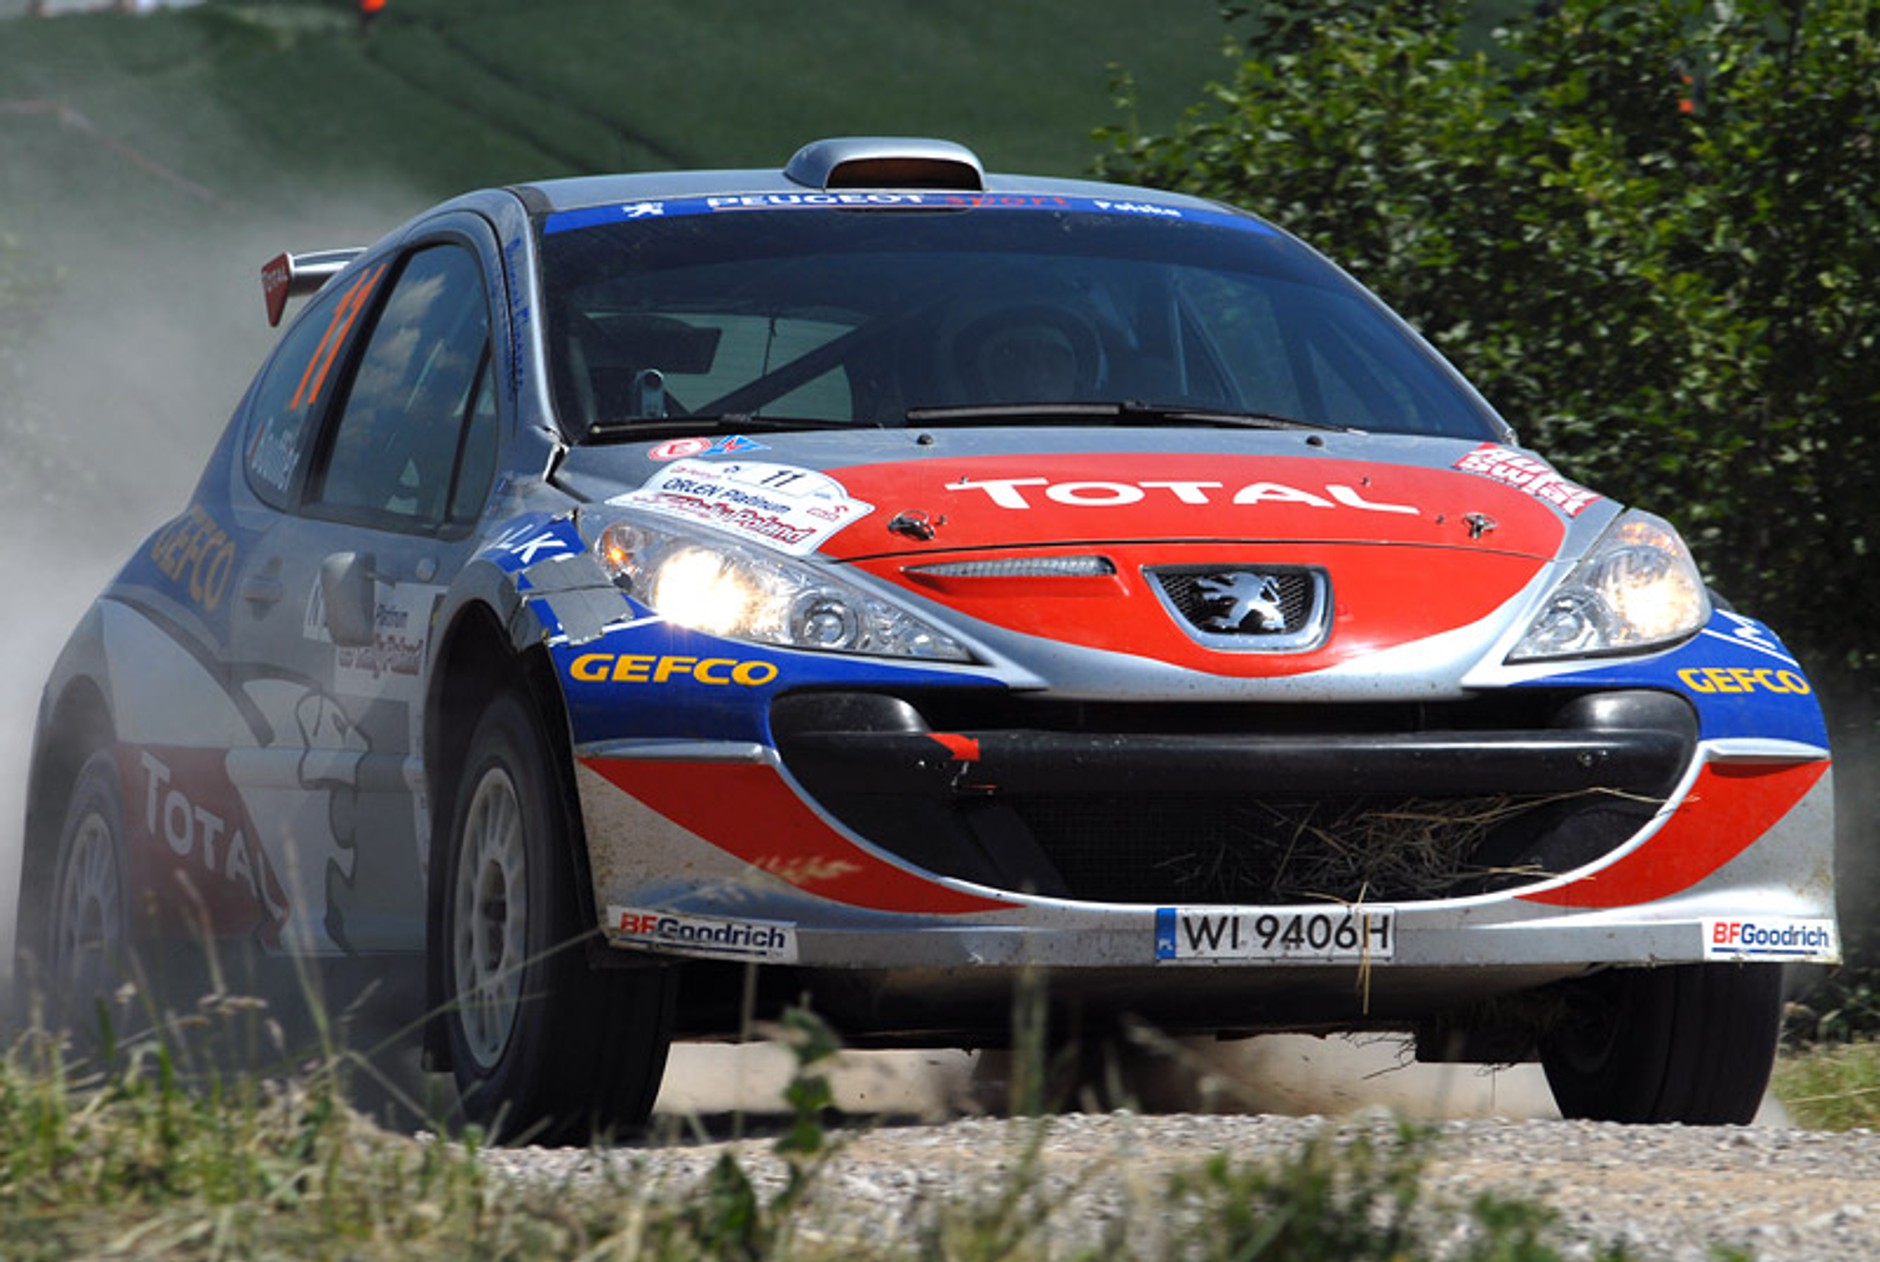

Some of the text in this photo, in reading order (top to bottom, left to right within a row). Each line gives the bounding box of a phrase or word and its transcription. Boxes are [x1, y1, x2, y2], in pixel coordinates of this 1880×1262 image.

[706, 194, 924, 208] PEUGEOT
[760, 470, 806, 488] 11
[945, 477, 1420, 515] TOTAL
[570, 653, 779, 686] GEFCO
[1677, 668, 1811, 695] GEFCO
[141, 750, 284, 922] TOTAL
[620, 912, 786, 948] BFGoodrich
[1183, 914, 1391, 951] WI 9406H
[1712, 921, 1829, 947] BFGoodrich
